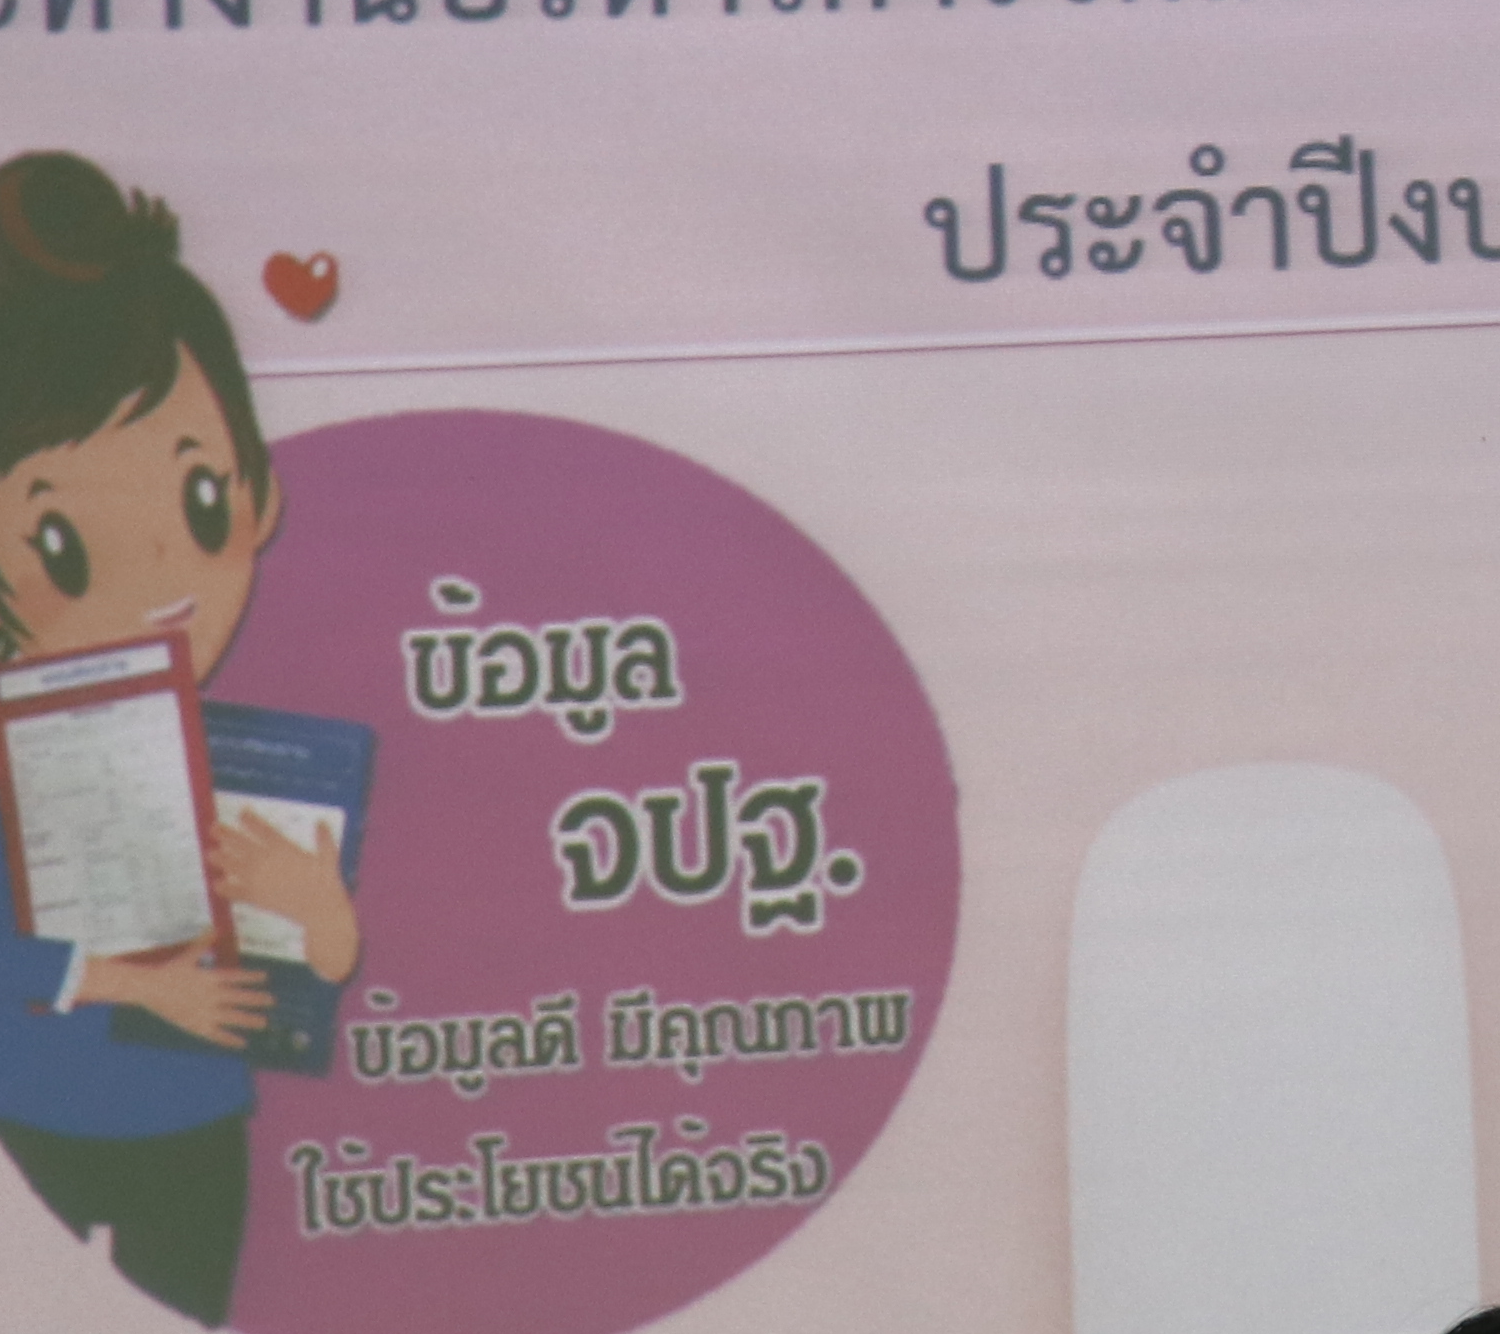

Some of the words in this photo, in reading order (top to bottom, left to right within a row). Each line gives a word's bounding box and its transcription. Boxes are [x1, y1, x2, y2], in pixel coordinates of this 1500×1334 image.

[404, 577, 682, 741] ข้อมูล
[550, 760, 864, 935] จปฐ.
[607, 985, 912, 1087] มีคุณภาพ
